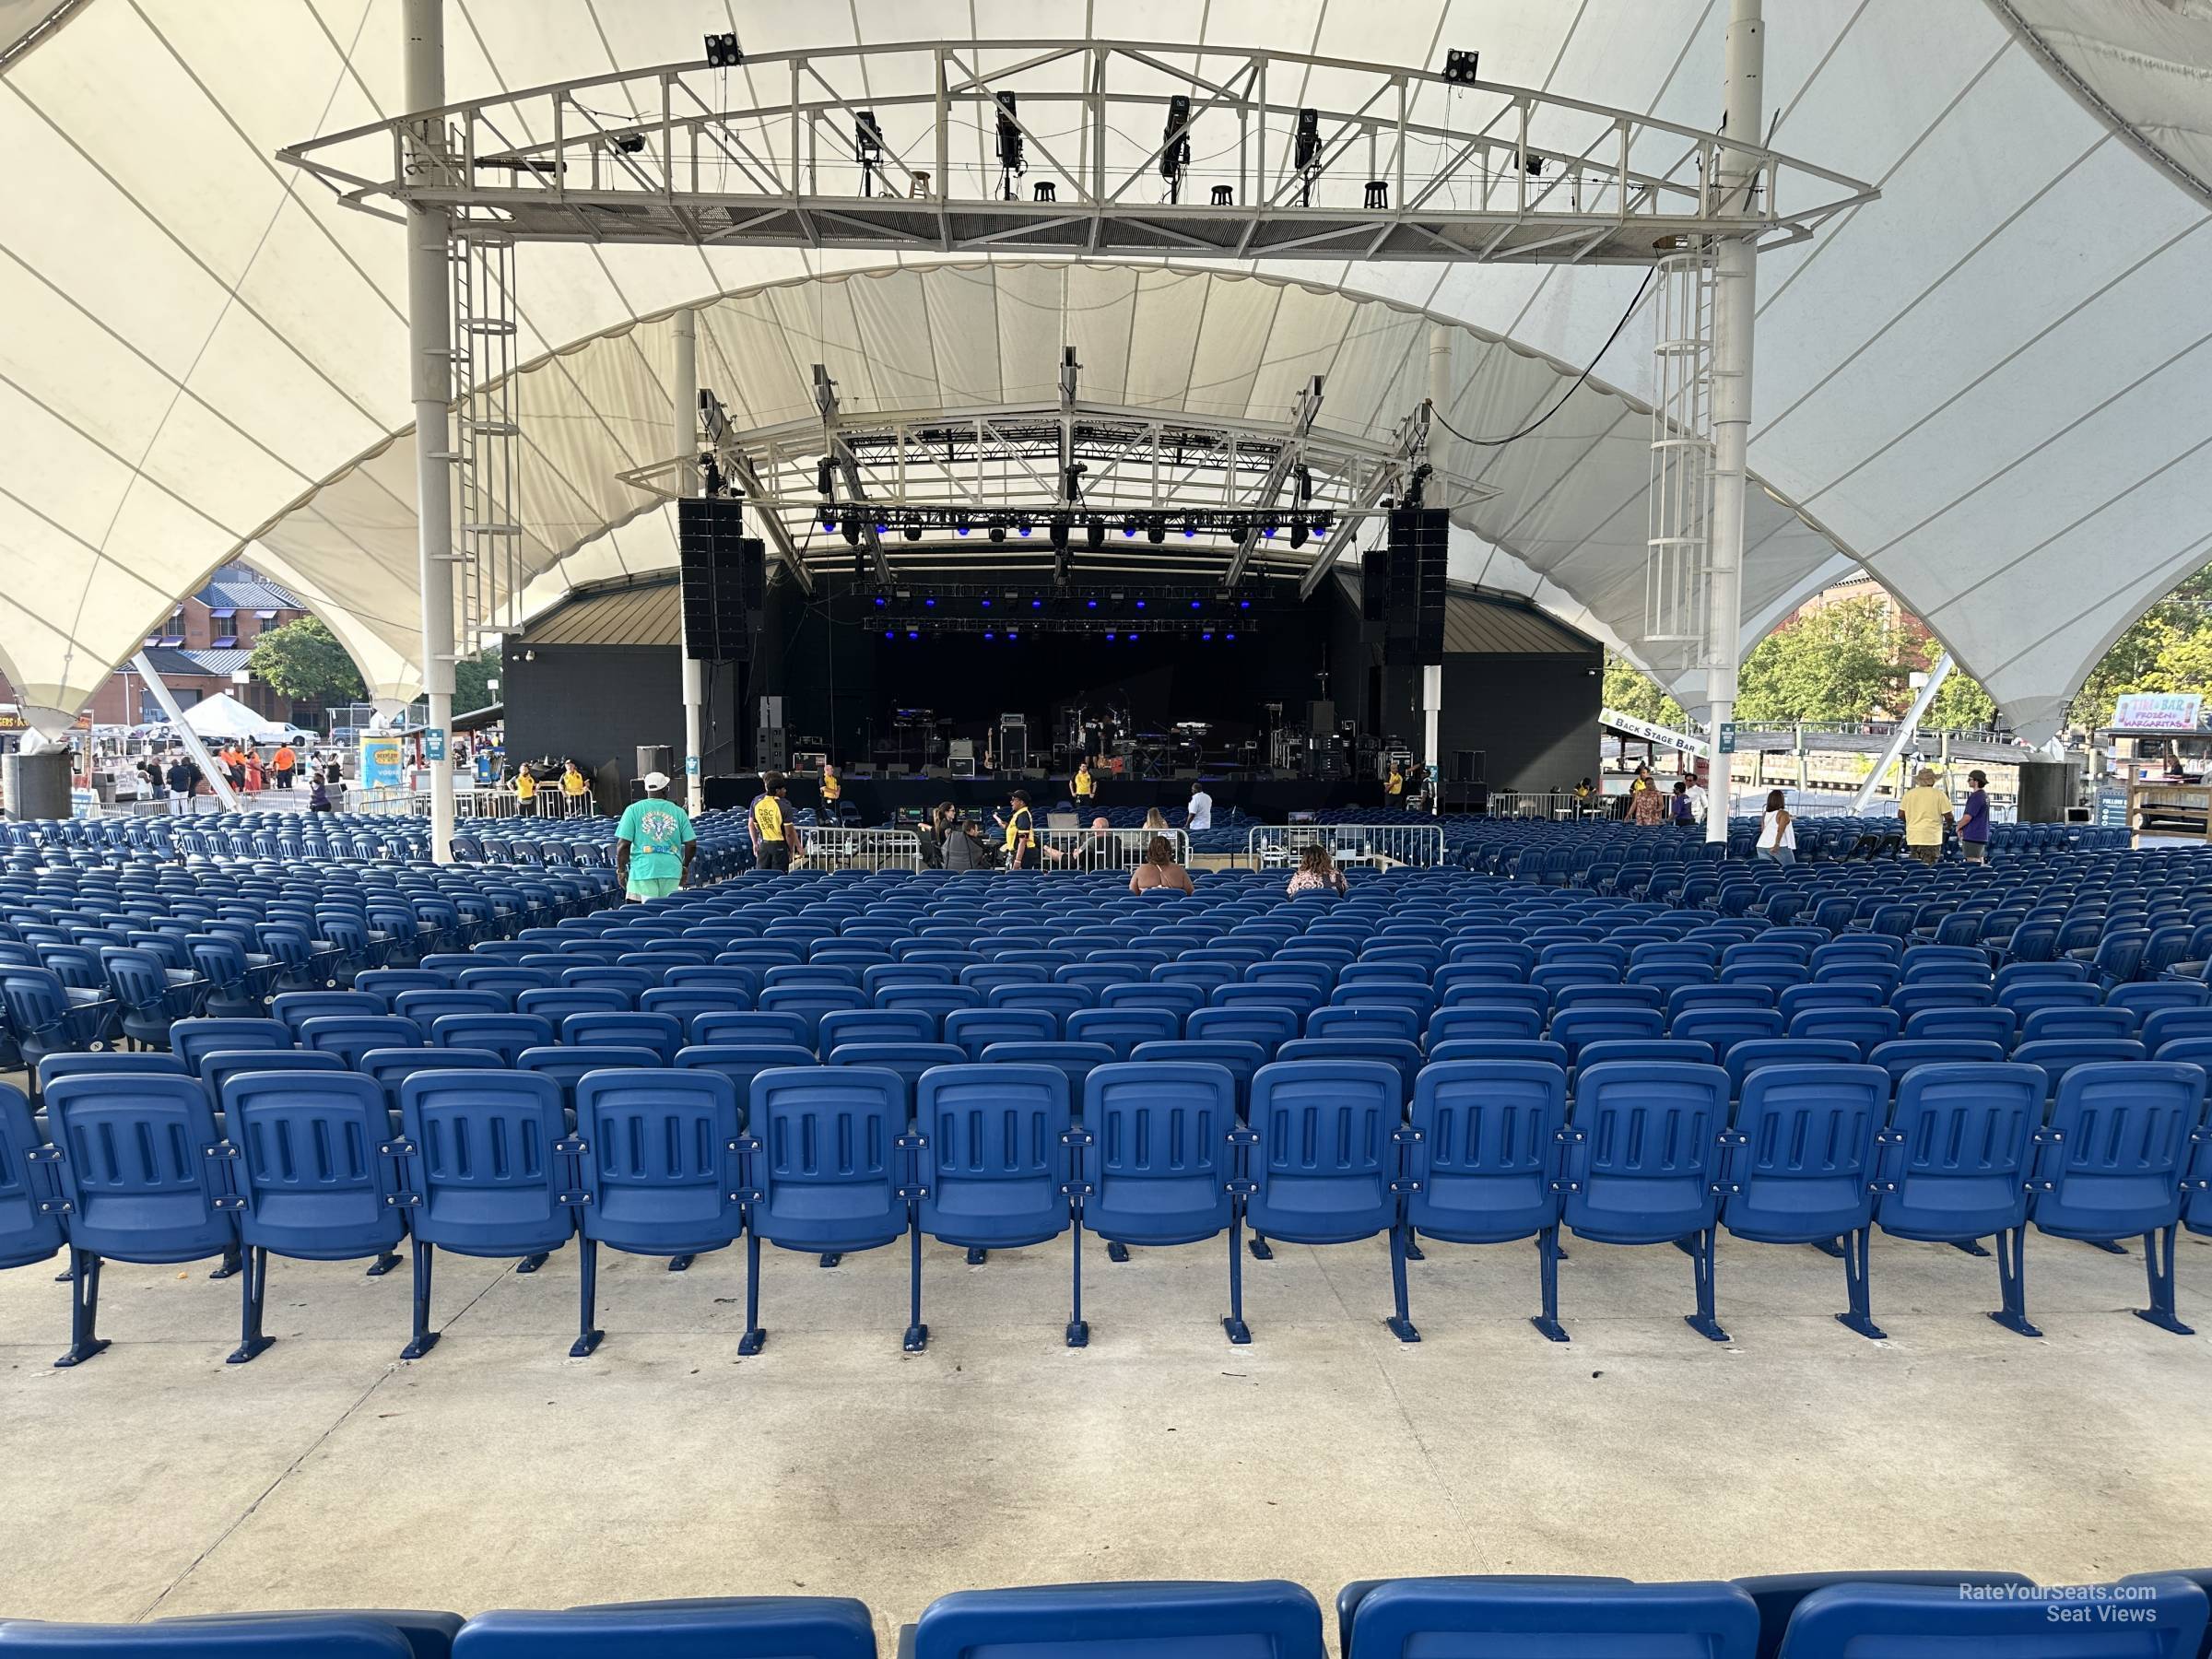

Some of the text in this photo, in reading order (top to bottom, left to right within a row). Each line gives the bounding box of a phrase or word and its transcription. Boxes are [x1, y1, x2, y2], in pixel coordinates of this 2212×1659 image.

[2161, 699, 2184, 712] BAR
[2124, 720, 2182, 728] MARGARITAS
[1616, 718, 1695, 752] BACK STAGE BAR
